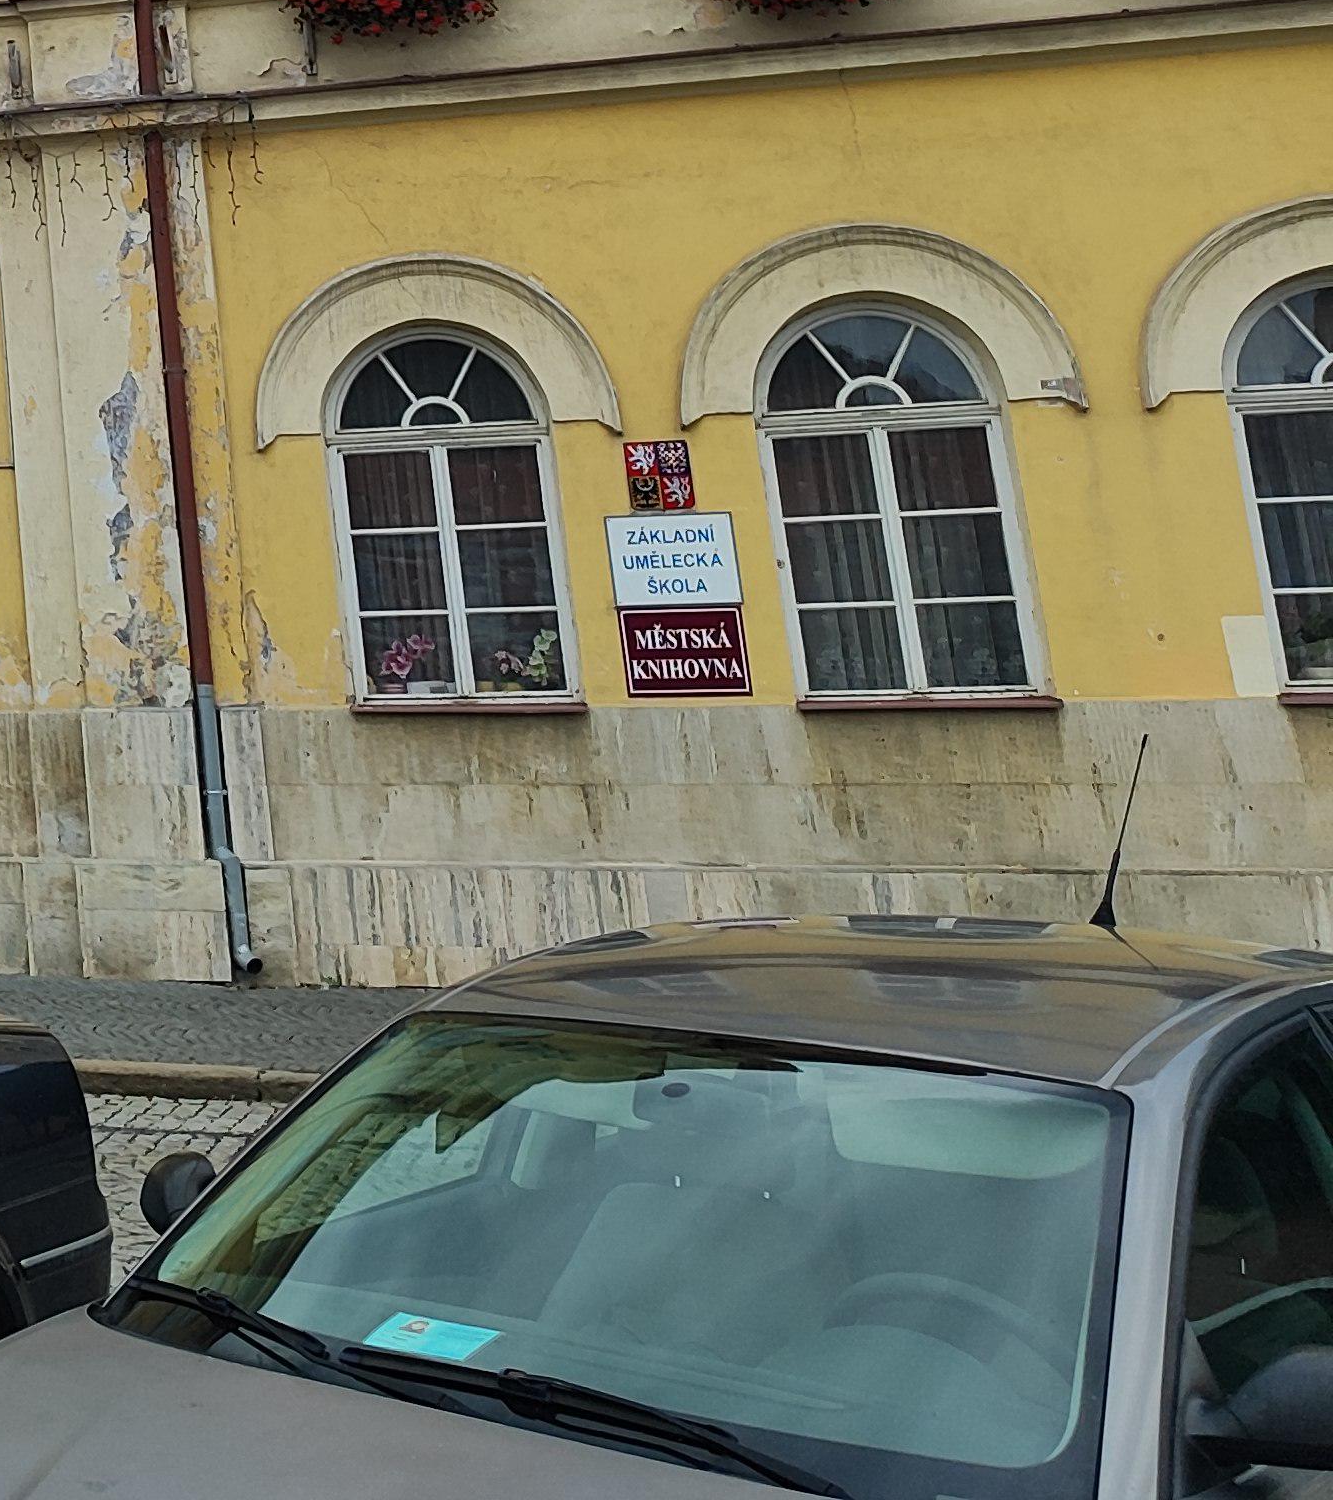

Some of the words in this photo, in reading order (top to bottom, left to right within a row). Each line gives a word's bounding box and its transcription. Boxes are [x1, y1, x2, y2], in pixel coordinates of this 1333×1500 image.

[626, 523, 715, 546] ZÁKLADNÍ
[622, 548, 724, 570] UMĚLECKÁ
[647, 575, 708, 595] ŠKOLA
[634, 621, 733, 650] MĚSTSKÁ
[631, 657, 744, 680] KNIHOVNA
